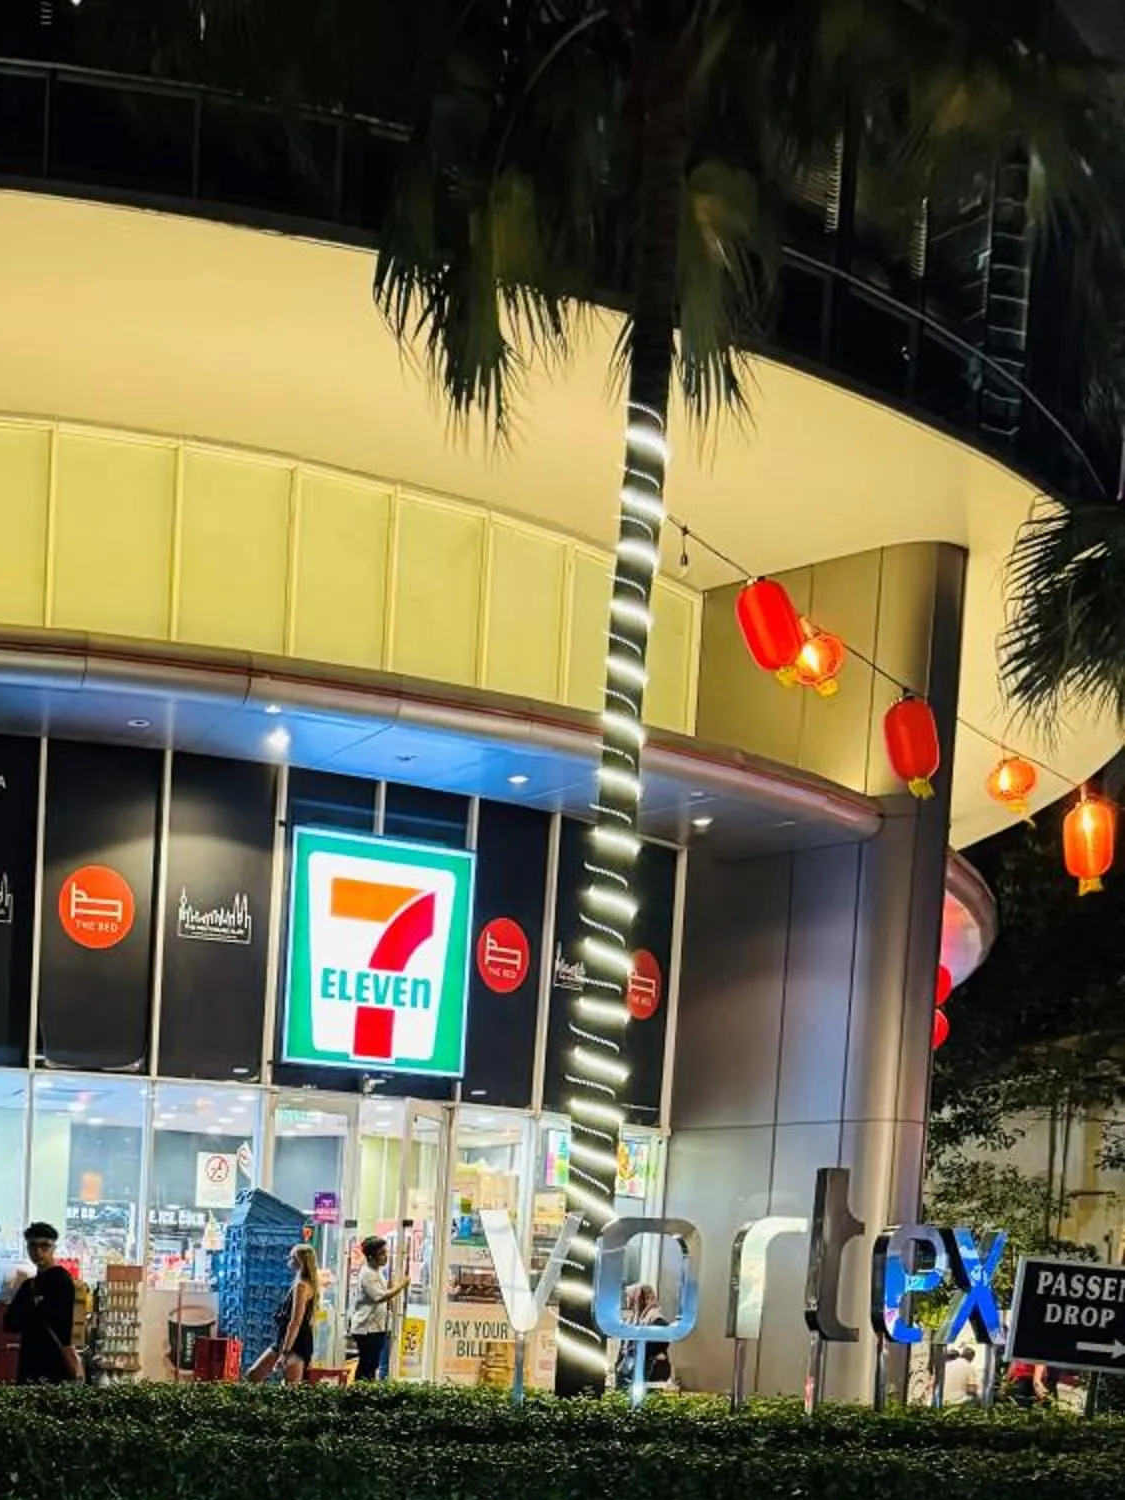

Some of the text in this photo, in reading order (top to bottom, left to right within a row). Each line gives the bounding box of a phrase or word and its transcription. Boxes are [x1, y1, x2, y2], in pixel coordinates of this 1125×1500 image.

[330, 877, 436, 1059] 7
[444, 1319, 508, 1339] PAY YOUR
[1044, 1303, 1116, 1329] DROP
